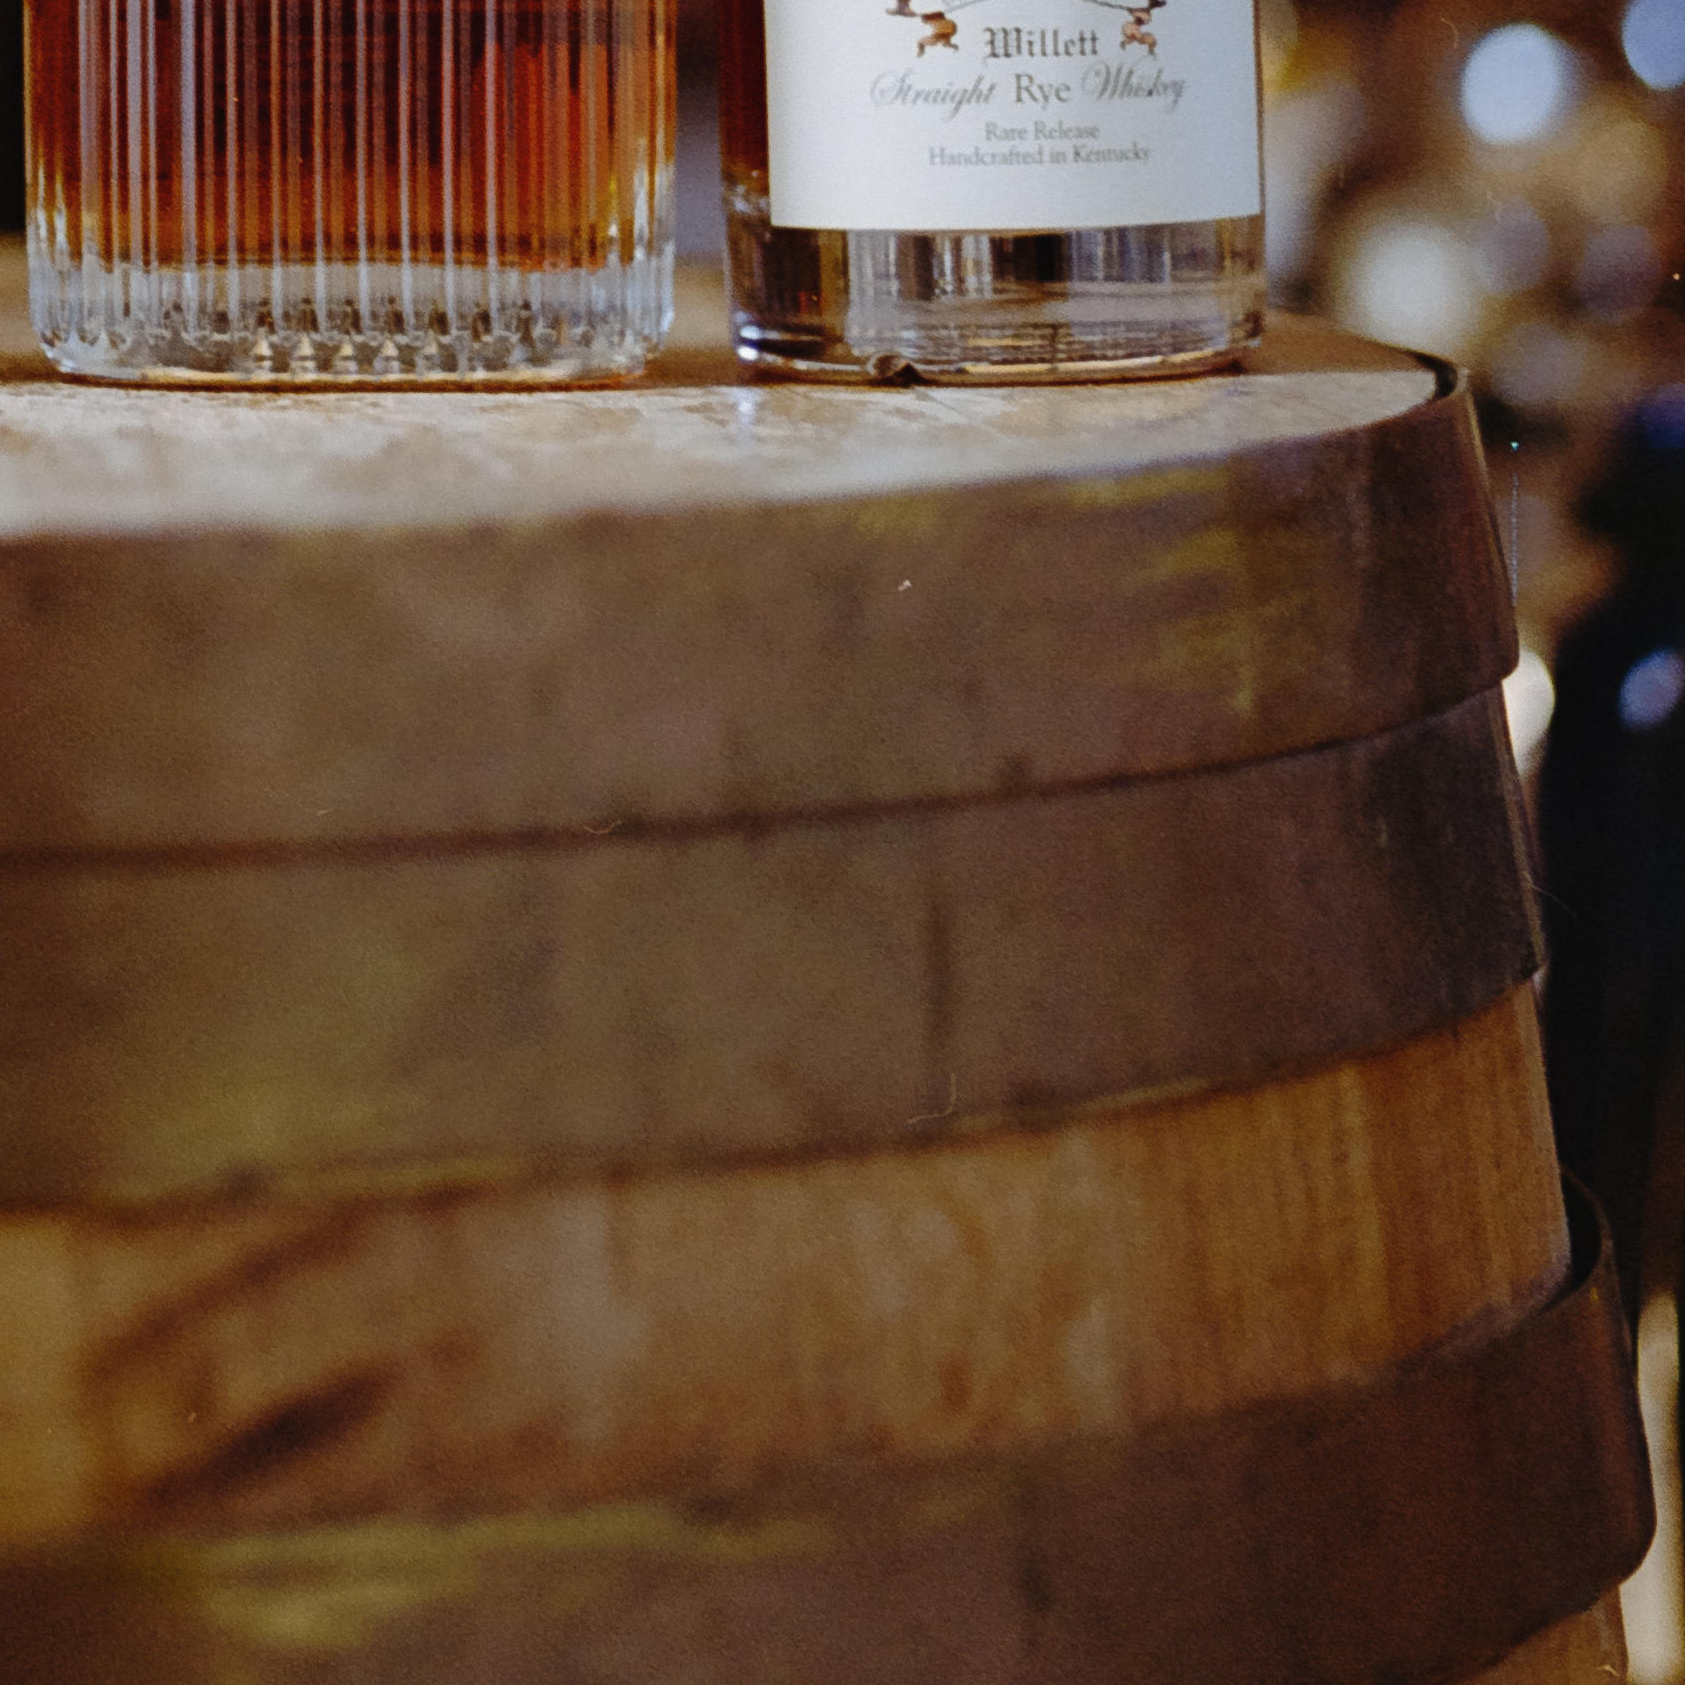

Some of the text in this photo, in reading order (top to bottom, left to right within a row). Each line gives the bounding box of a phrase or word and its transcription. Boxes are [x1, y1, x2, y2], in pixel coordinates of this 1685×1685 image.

[984, 26, 1100, 61] Willett
[870, 67, 997, 121] Straight
[1013, 73, 1072, 111] Rye
[984, 121, 1101, 142] Rare Release
[929, 142, 1152, 166] Handcrafted in Kentucky
